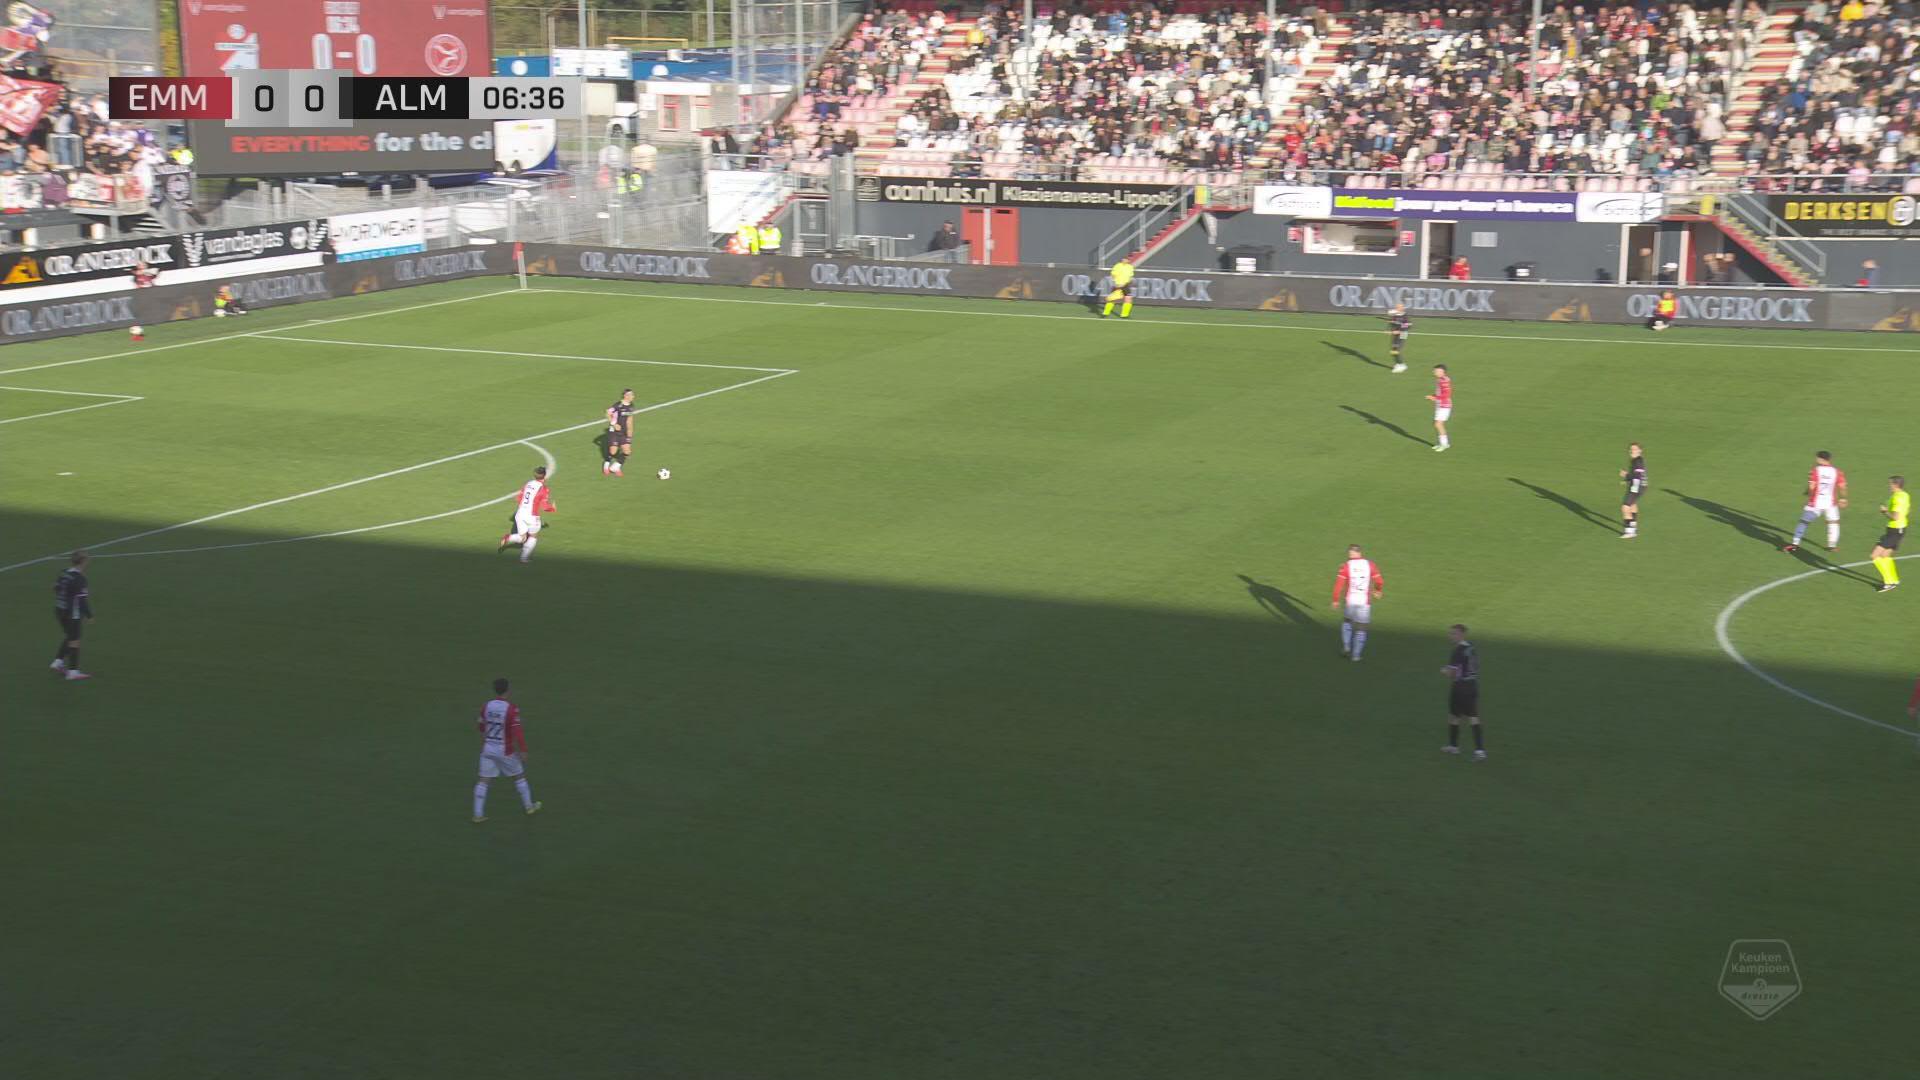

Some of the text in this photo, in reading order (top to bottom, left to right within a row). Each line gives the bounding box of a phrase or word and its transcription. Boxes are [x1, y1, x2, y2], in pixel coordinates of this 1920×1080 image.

[231, 135, 370, 153] EVERYTHING
[375, 132, 414, 152] for
[420, 131, 463, 151] the
[1784, 201, 1888, 221] DERKSEN
[44, 243, 174, 276] ORANGEROCK
[580, 251, 710, 279] ORANGEROCK
[811, 263, 952, 291] ORANGEROCK
[1329, 284, 1495, 312] ORANGEROCK
[486, 721, 503, 741] 22
